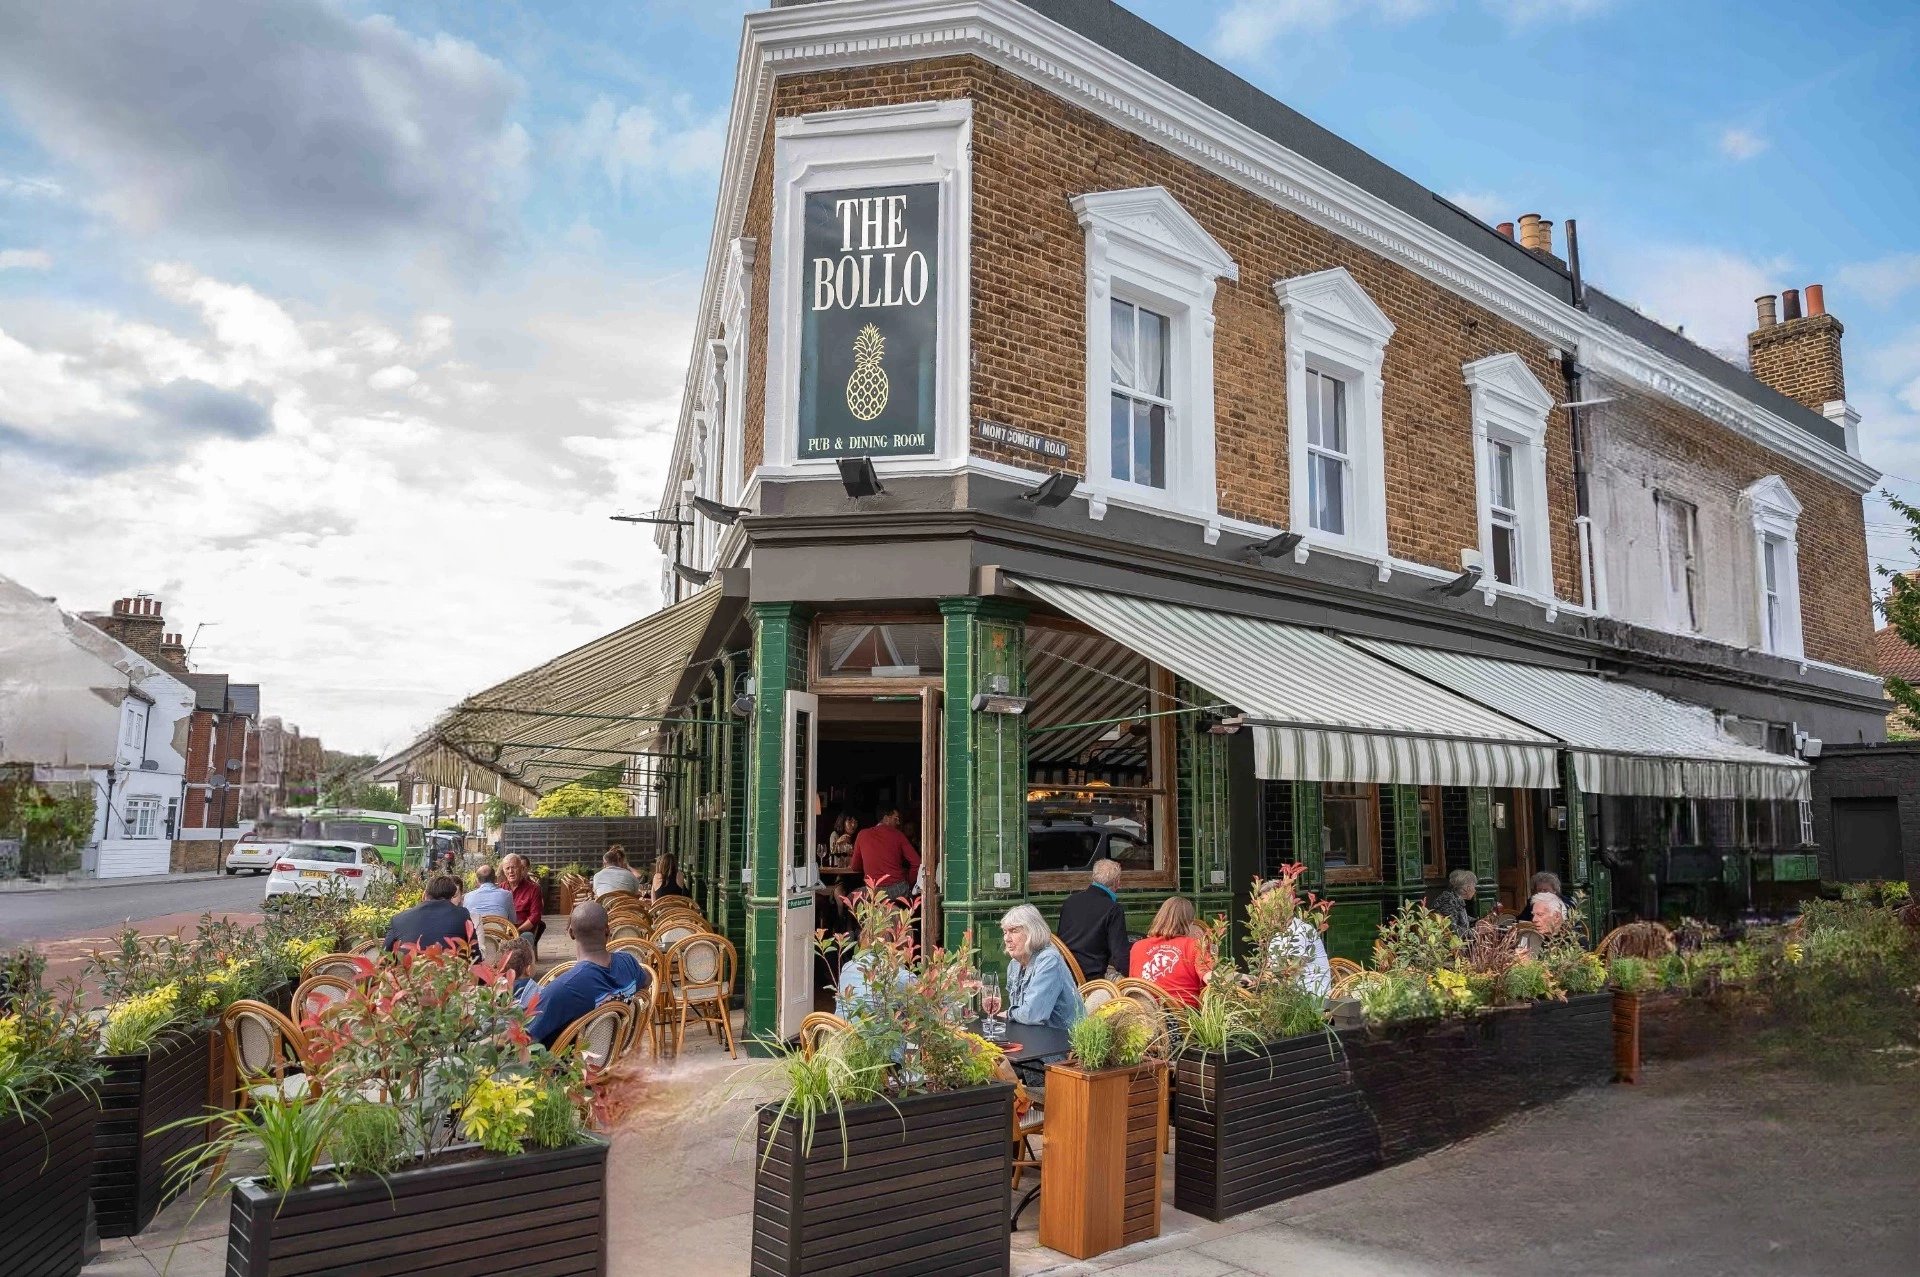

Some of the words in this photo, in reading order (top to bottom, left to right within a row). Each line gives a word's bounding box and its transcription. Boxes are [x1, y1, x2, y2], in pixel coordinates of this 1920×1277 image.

[835, 194, 908, 252] THE
[811, 250, 929, 312] BOLLO
[807, 437, 830, 451] PUB
[834, 436, 844, 450] &
[848, 434, 888, 449] DINING
[893, 433, 926, 448] ROOM
[1044, 440, 1066, 457] ROAD
